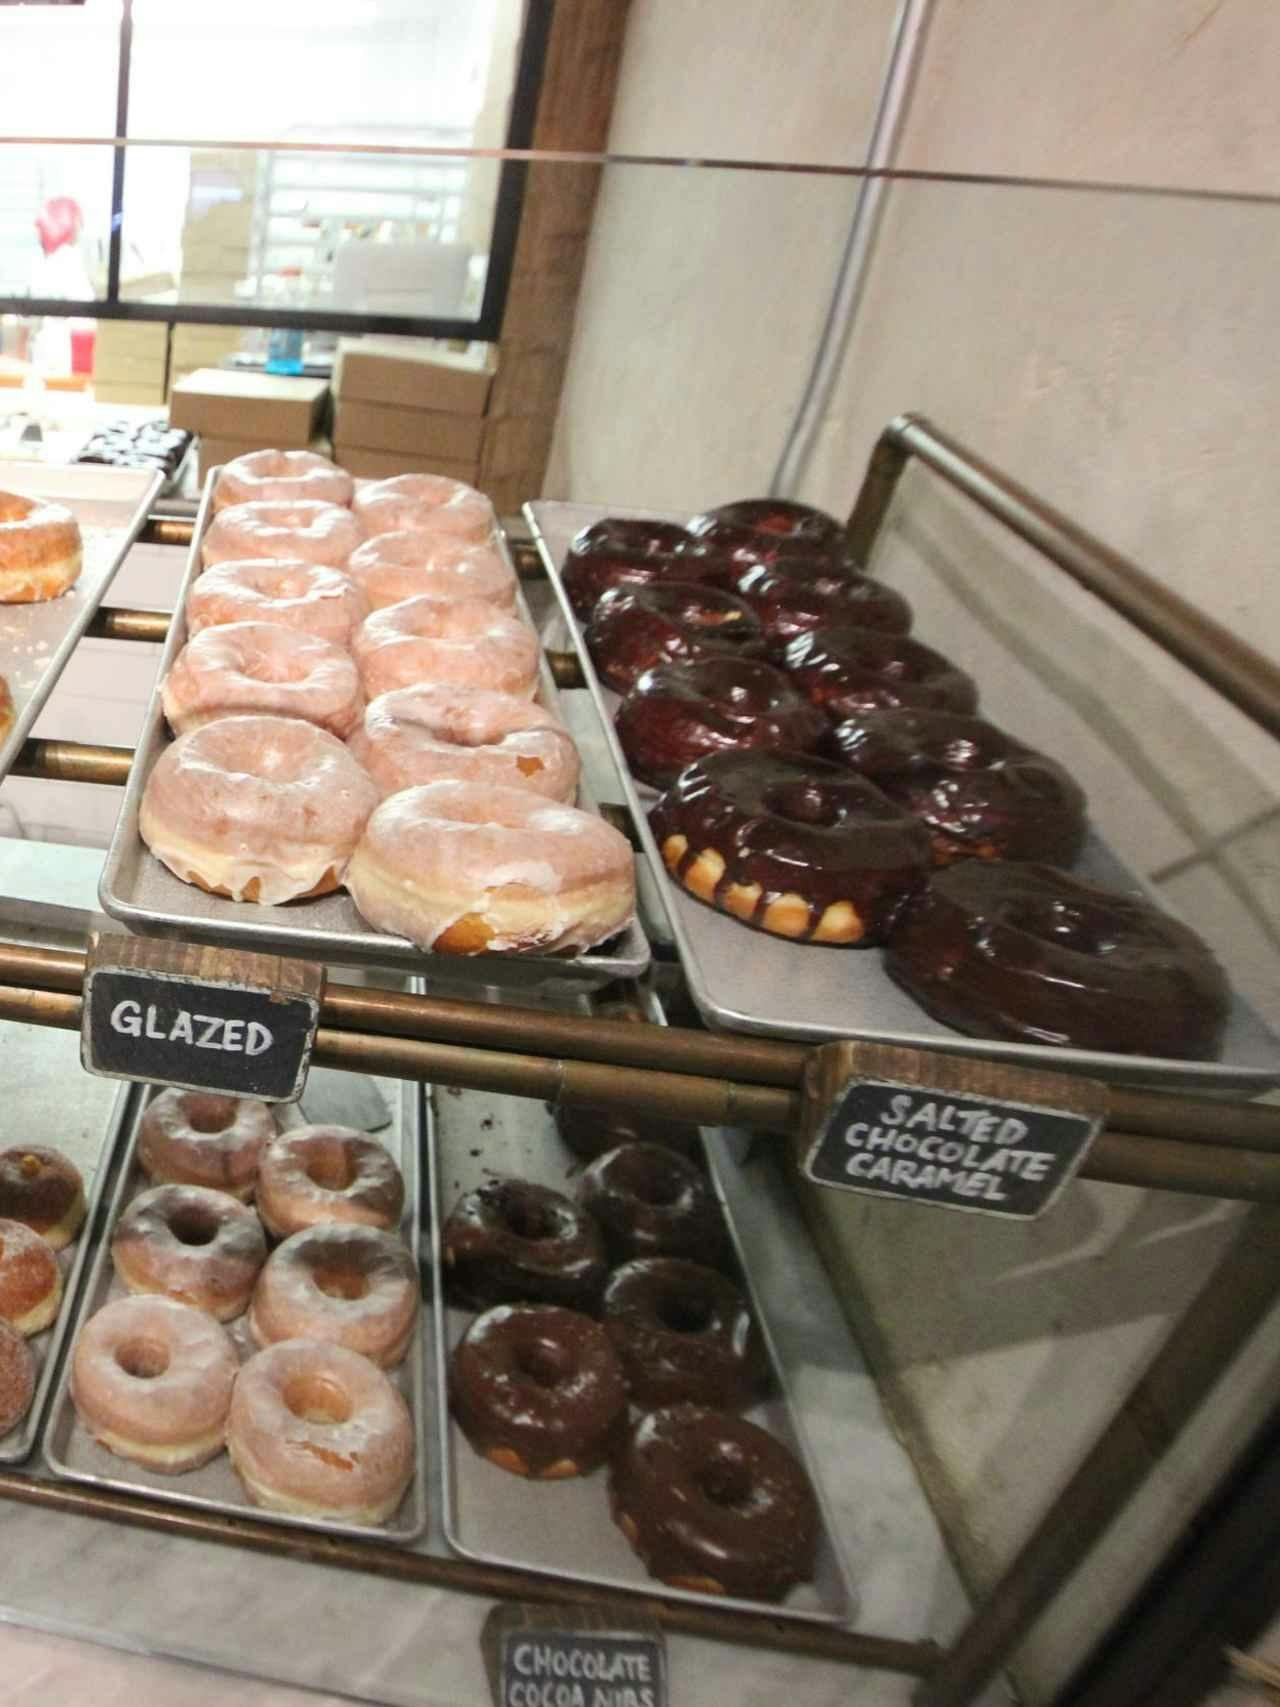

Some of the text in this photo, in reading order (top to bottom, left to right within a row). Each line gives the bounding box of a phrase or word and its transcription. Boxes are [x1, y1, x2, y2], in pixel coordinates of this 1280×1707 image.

[110, 1000, 274, 1056] GLAZED
[880, 1094, 1029, 1145] SALTED
[844, 1122, 1056, 1182] CHOCOLATE
[845, 1152, 1009, 1201] CARAMEL
[513, 1643, 651, 1682] CHOCOLATE
[509, 1681, 585, 1707] COCOA
